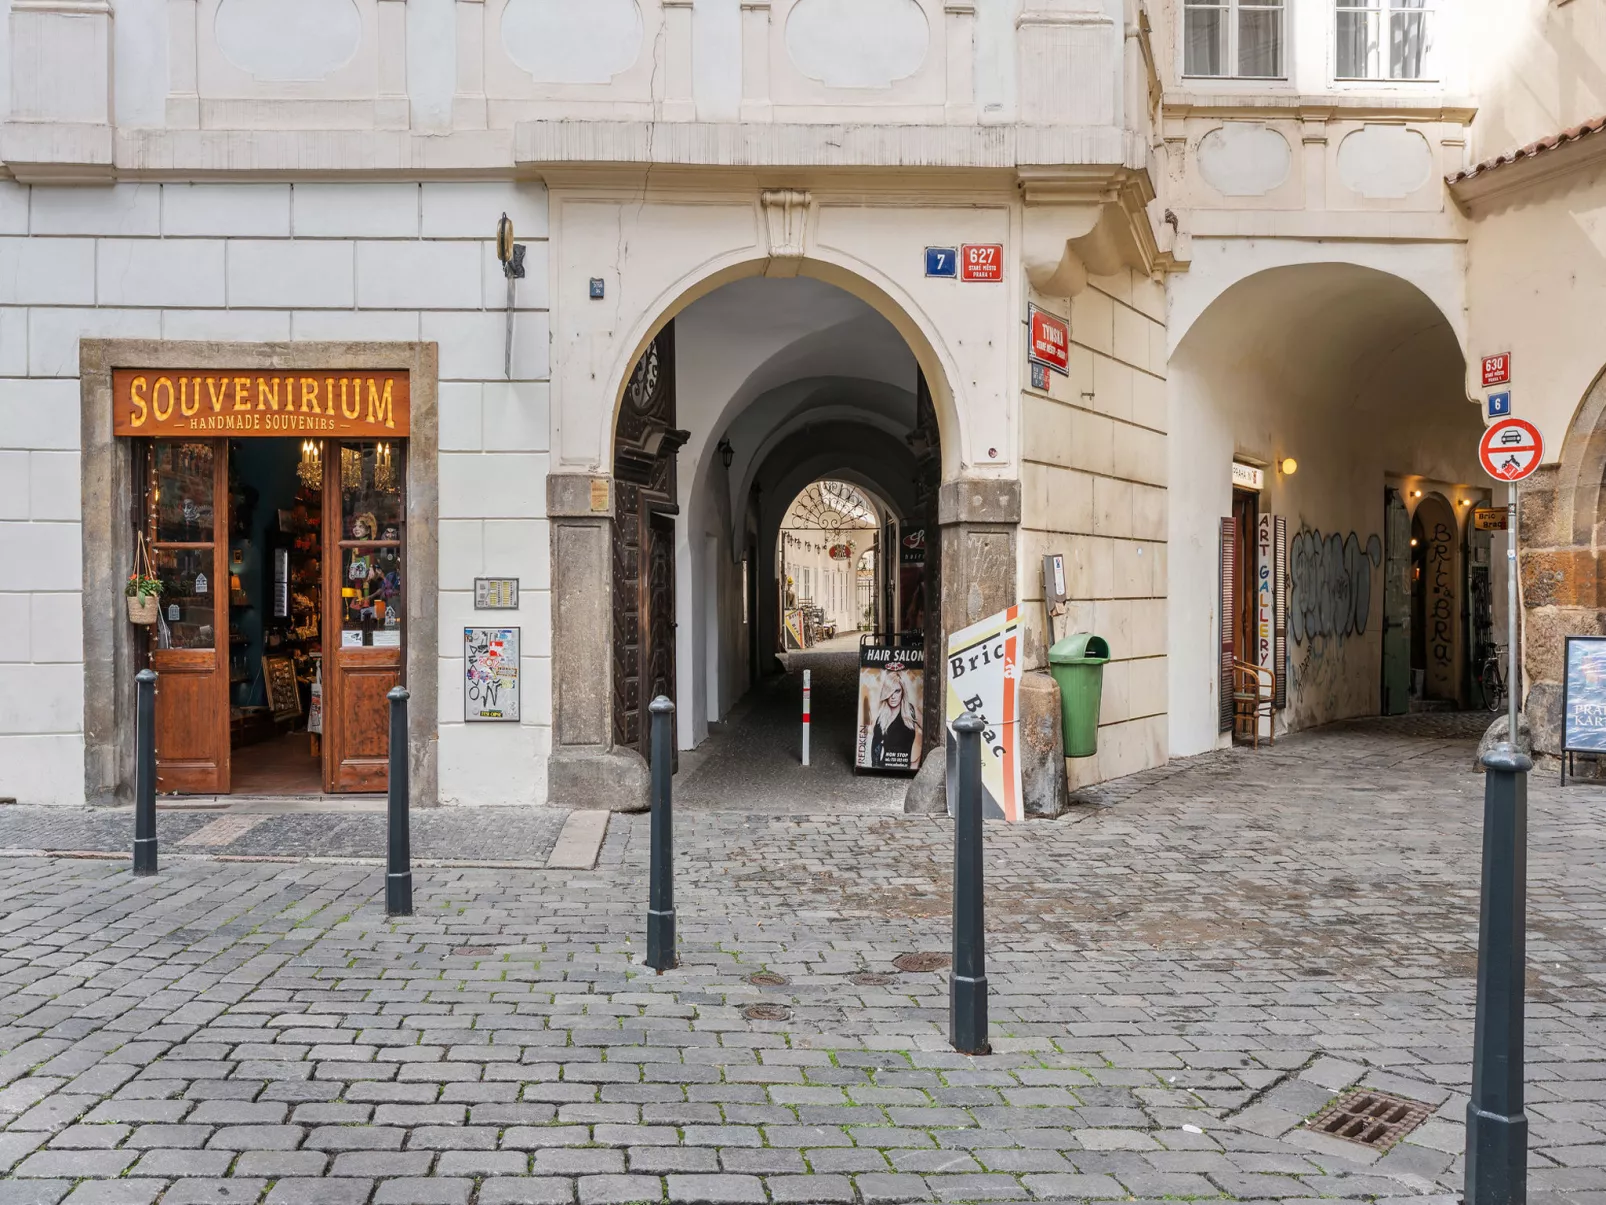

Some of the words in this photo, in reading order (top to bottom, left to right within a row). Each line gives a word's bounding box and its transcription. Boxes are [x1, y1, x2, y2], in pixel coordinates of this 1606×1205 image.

[937, 254, 946, 270] 7
[970, 248, 995, 263] 627
[1042, 322, 1064, 346] TÝNSKÁ
[1485, 358, 1503, 372] 630
[129, 375, 395, 429] SOUVENIRIUM
[1495, 398, 1501, 410] 6
[190, 414, 260, 430] HANDMADE
[265, 414, 335, 430] SOUVENIRS
[1259, 515, 1270, 556] ART
[1259, 565, 1270, 666] GALLERY
[867, 649, 890, 661] HAIR
[893, 650, 925, 662] SALON
[950, 643, 1004, 679] Bric
[1004, 657, 1016, 679] à
[857, 725, 868, 765] REDKEN
